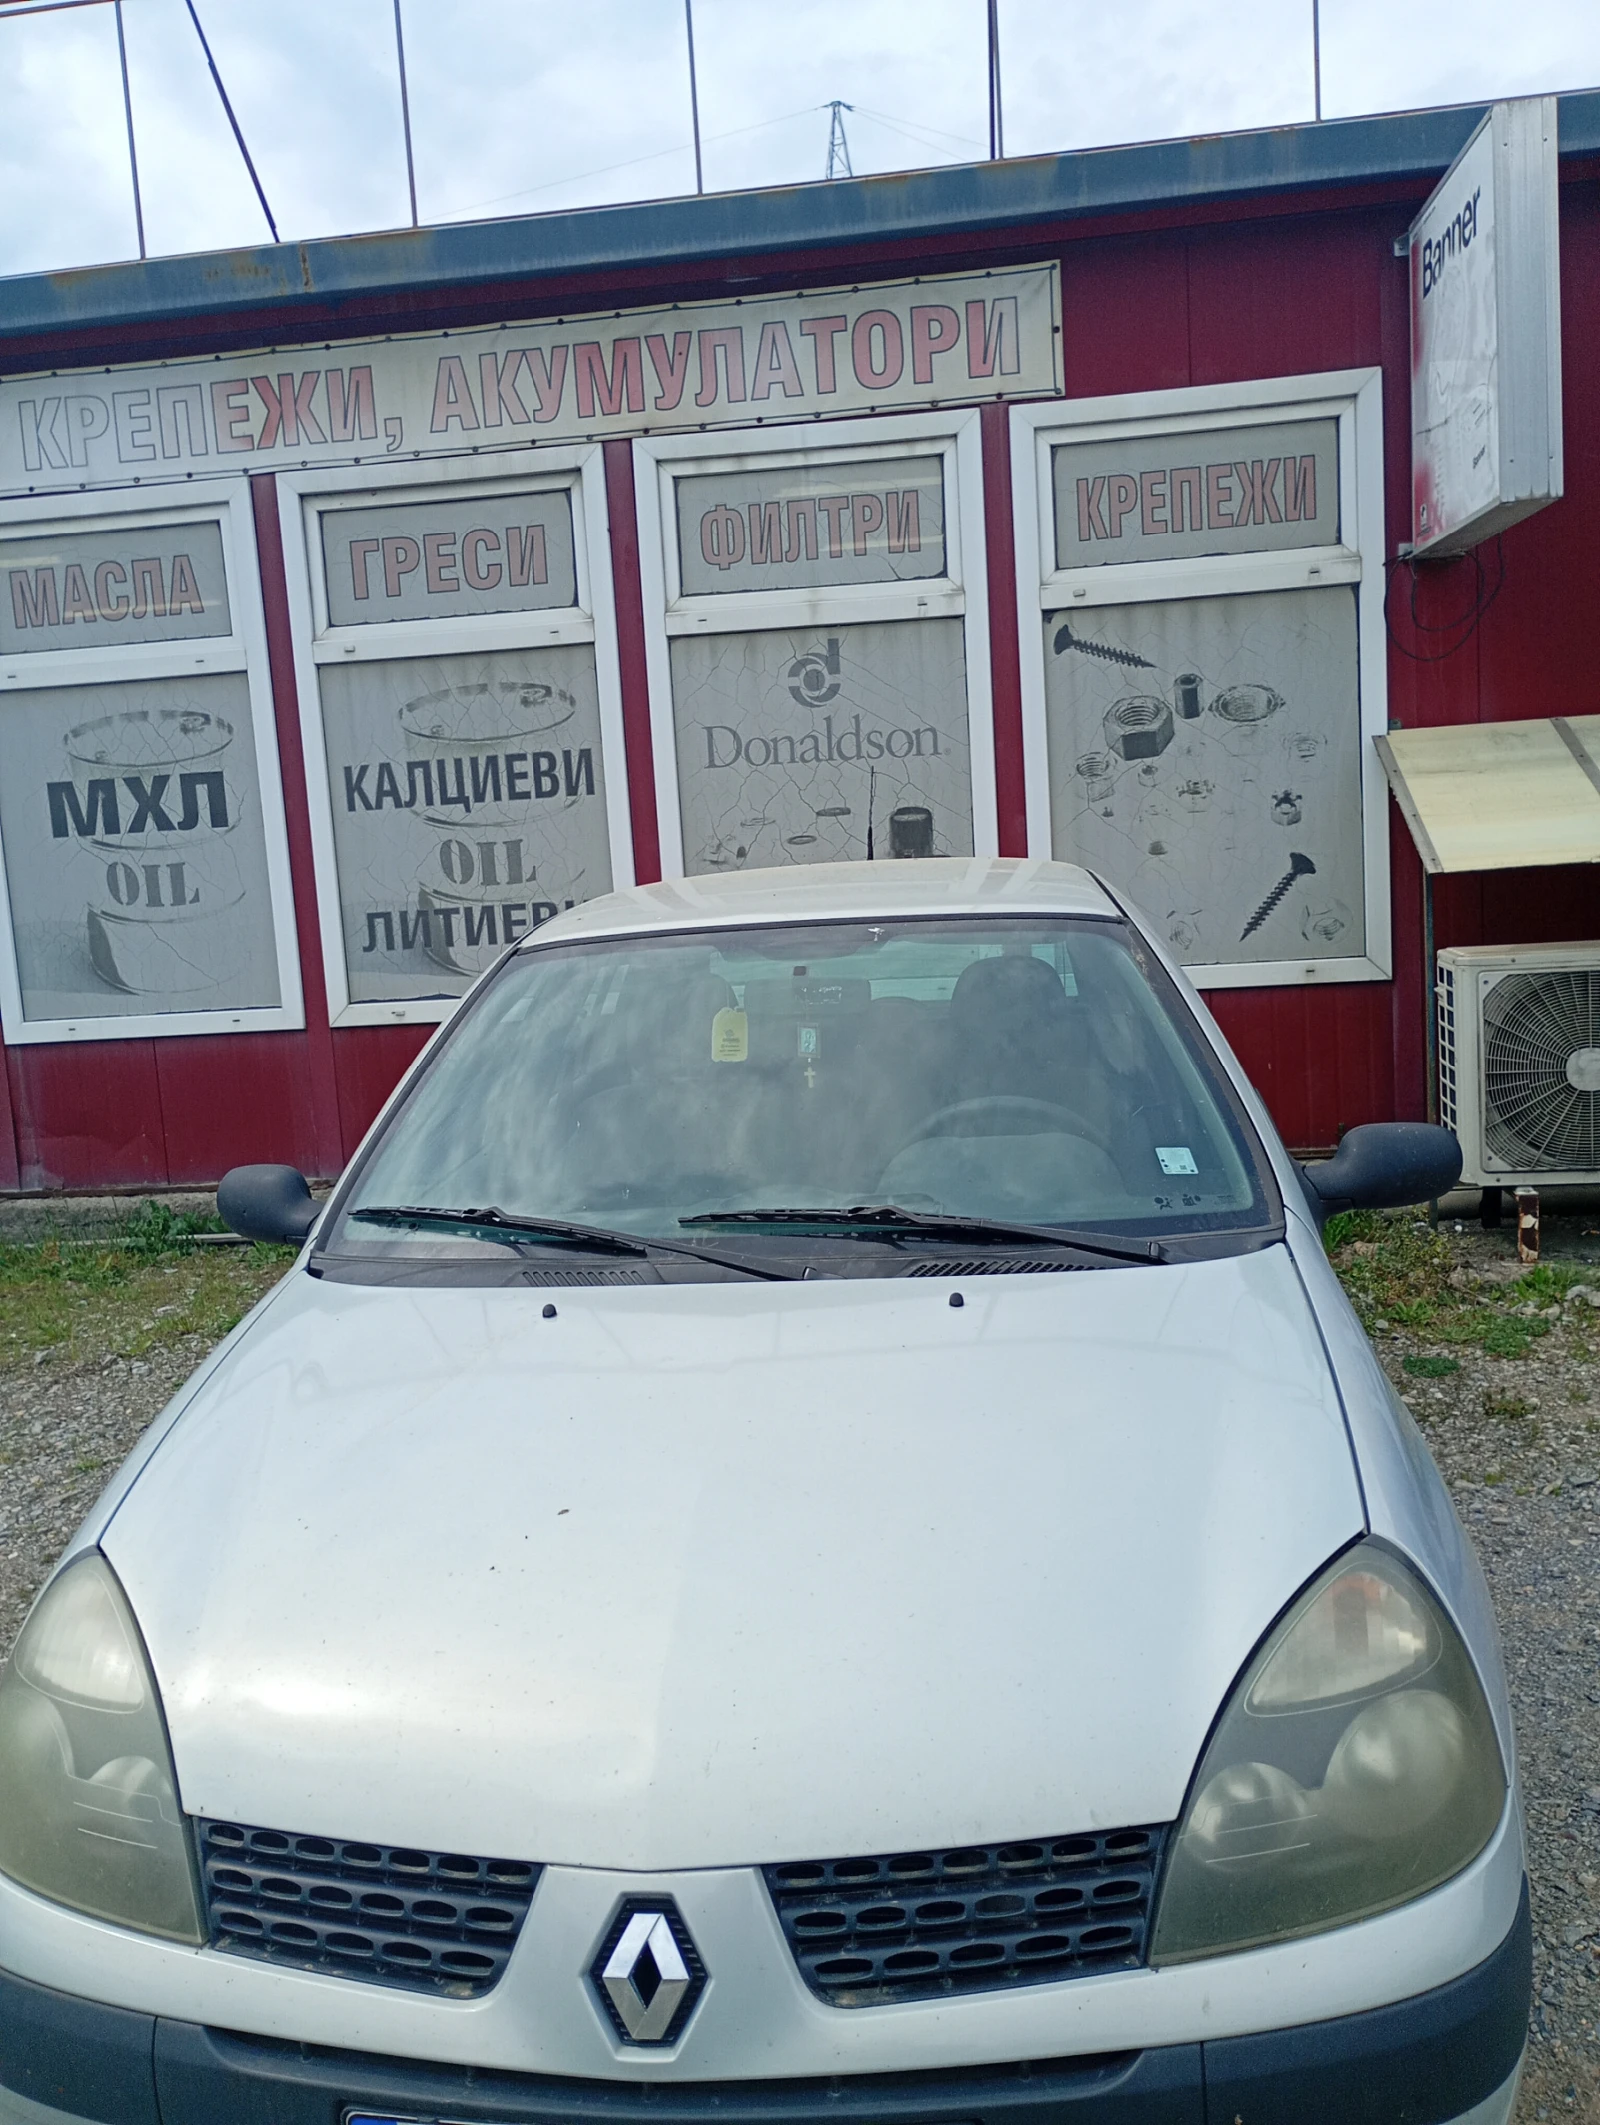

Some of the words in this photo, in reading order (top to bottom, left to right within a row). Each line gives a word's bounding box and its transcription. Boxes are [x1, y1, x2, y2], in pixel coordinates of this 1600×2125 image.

[1422, 185, 1480, 299] Banner
[18, 365, 403, 472] КРЕПЕЖИ,
[430, 296, 1020, 433] АКУМУЛАТОРИ
[700, 490, 921, 571] ФИЛТРИ
[1076, 454, 1316, 542] КРЕПЕЖИ
[9, 554, 204, 629] МАСЛА
[349, 524, 548, 600] ГРЕСИ
[702, 713, 942, 769] Donaldson
[46, 771, 229, 838] МХЛ
[343, 748, 596, 813] КАЛЦИЕВИ
[106, 862, 199, 908] OIL
[440, 838, 537, 886] OIL
